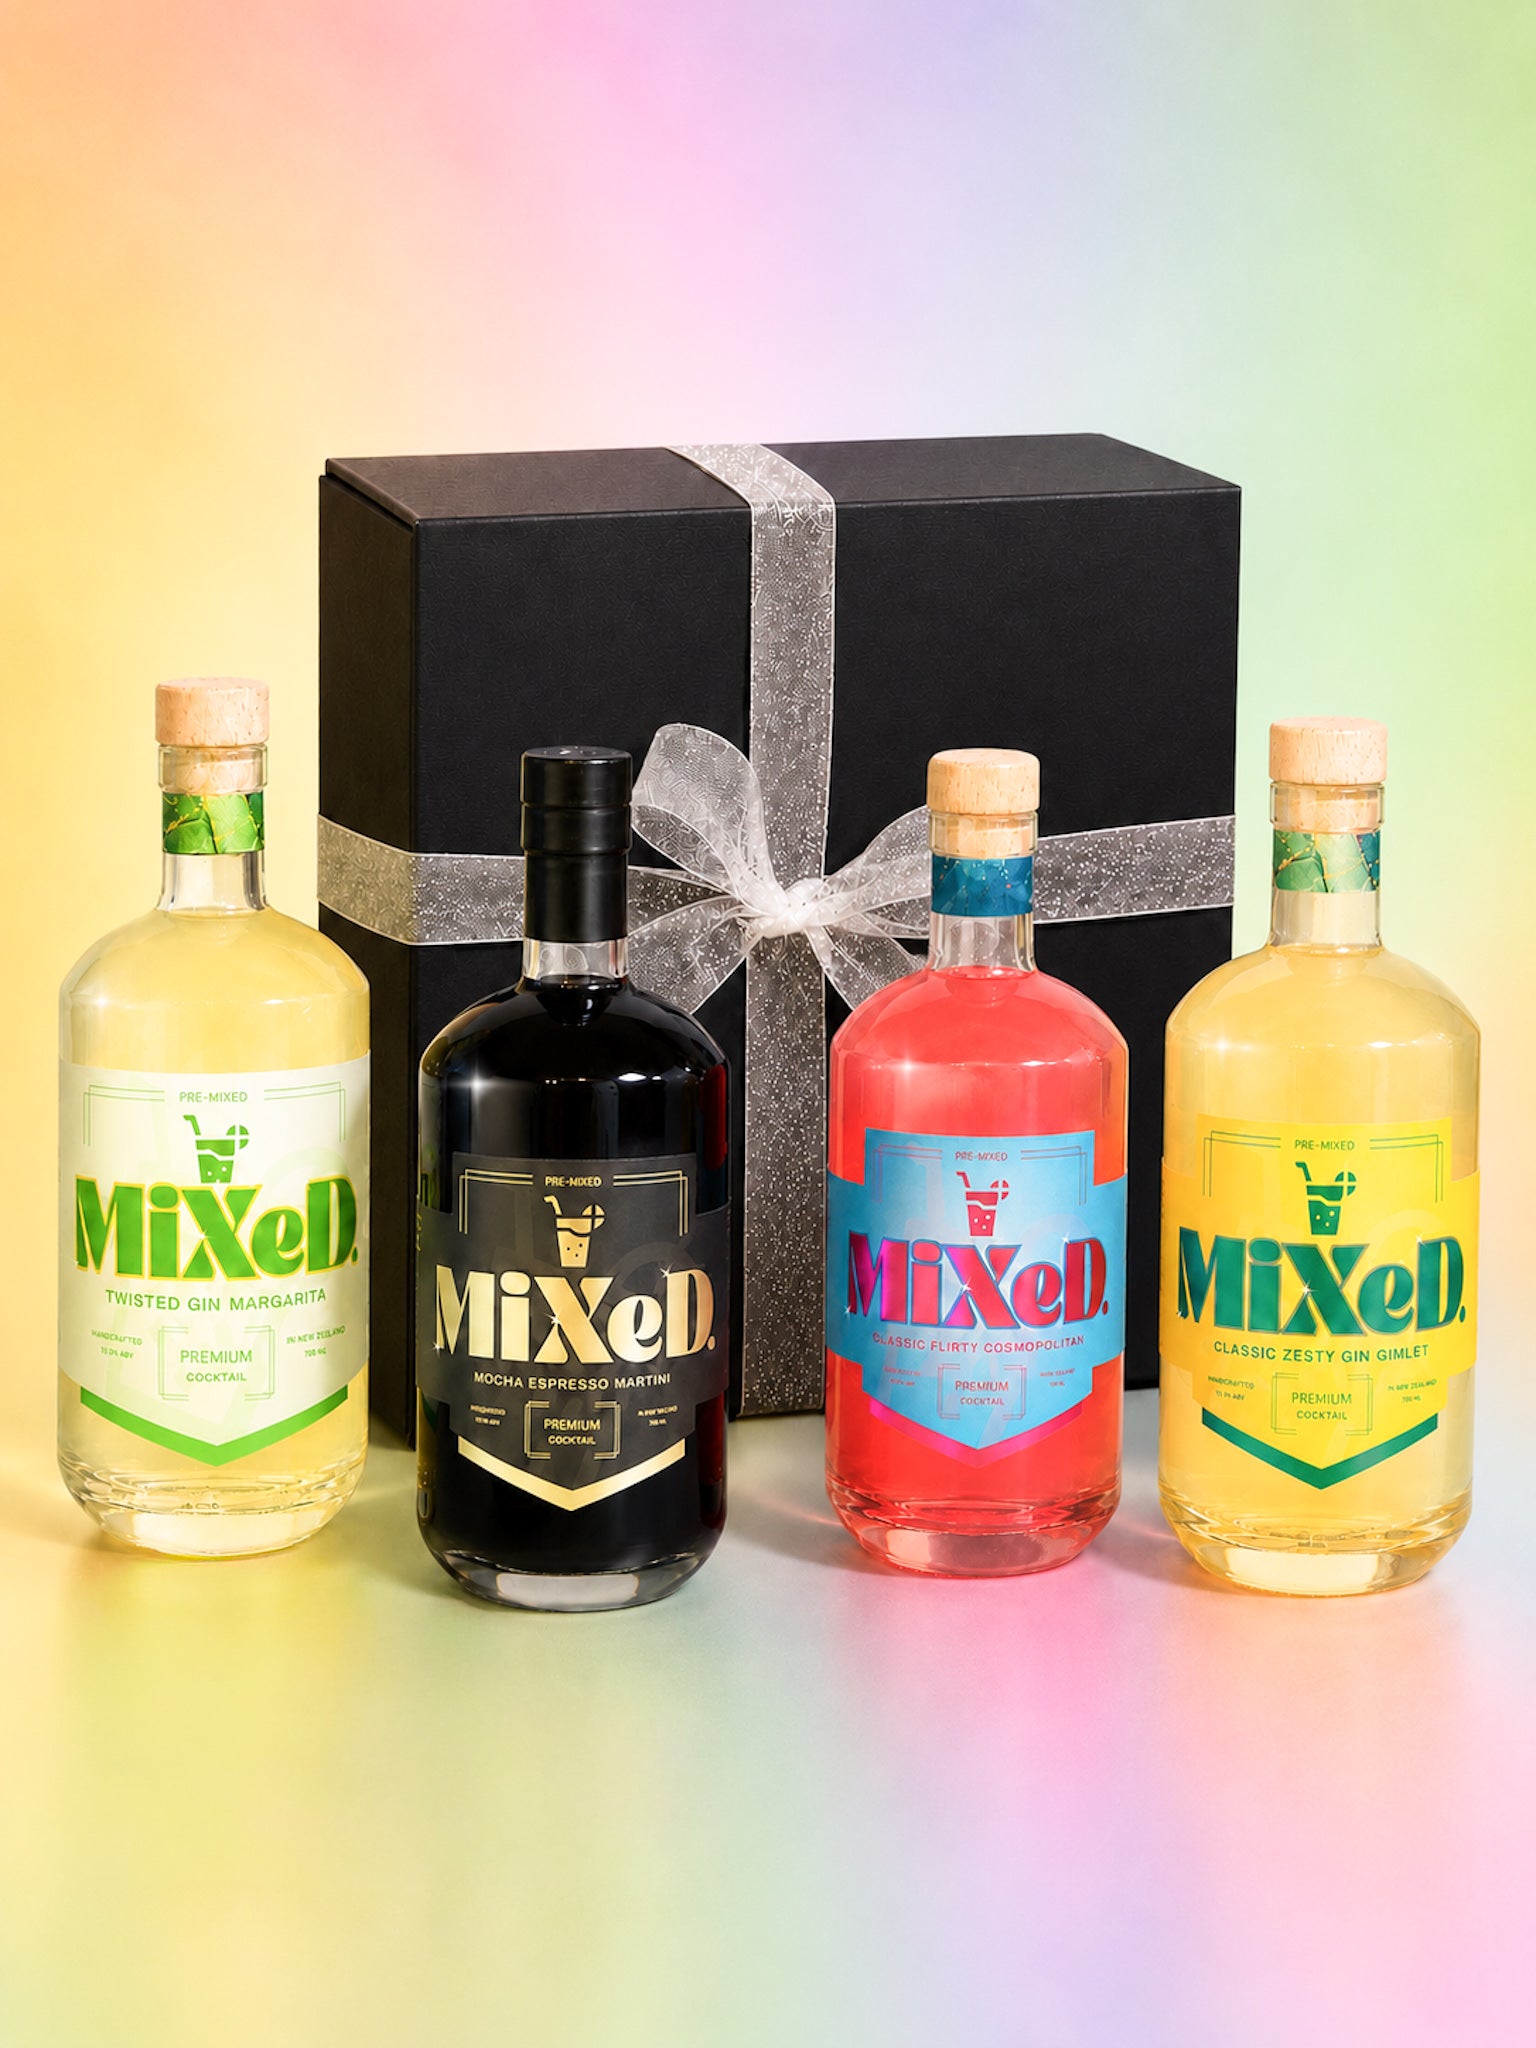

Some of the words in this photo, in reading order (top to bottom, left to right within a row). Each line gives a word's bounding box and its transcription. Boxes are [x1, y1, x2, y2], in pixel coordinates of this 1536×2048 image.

[179, 1091, 249, 1103] PRE-MIXED
[1295, 1139, 1355, 1152] PRE-MIXED
[955, 1151, 1009, 1162] PRE-MIXED
[545, 1176, 602, 1188] PRE-MIXED
[105, 1289, 181, 1311] TWISTED
[187, 1297, 221, 1312] GIN
[229, 1288, 327, 1311] MARGARITA
[872, 1332, 926, 1351] CLASSIC
[930, 1340, 979, 1353] FLIRTY
[983, 1335, 1085, 1354] COSMOPOLITAN
[179, 1349, 253, 1365] PREMIUM
[1213, 1340, 1277, 1361] CLASSIC
[1282, 1348, 1334, 1364] ZESTY
[1341, 1350, 1371, 1363] GIN
[1377, 1344, 1429, 1362] GIMLET
[185, 1371, 247, 1383] COCKTAIL
[474, 1371, 524, 1388] MOCHA
[528, 1376, 610, 1391] ESPRESSO
[614, 1372, 671, 1389] MARTINI
[955, 1380, 1010, 1393] PREMIUM
[960, 1396, 1006, 1406] COCKTAIL
[1291, 1392, 1353, 1406] PREMIUM
[1296, 1410, 1348, 1421] COCKTAIL
[544, 1417, 601, 1432] PREMIUM
[548, 1434, 597, 1446] COCKTAIL
